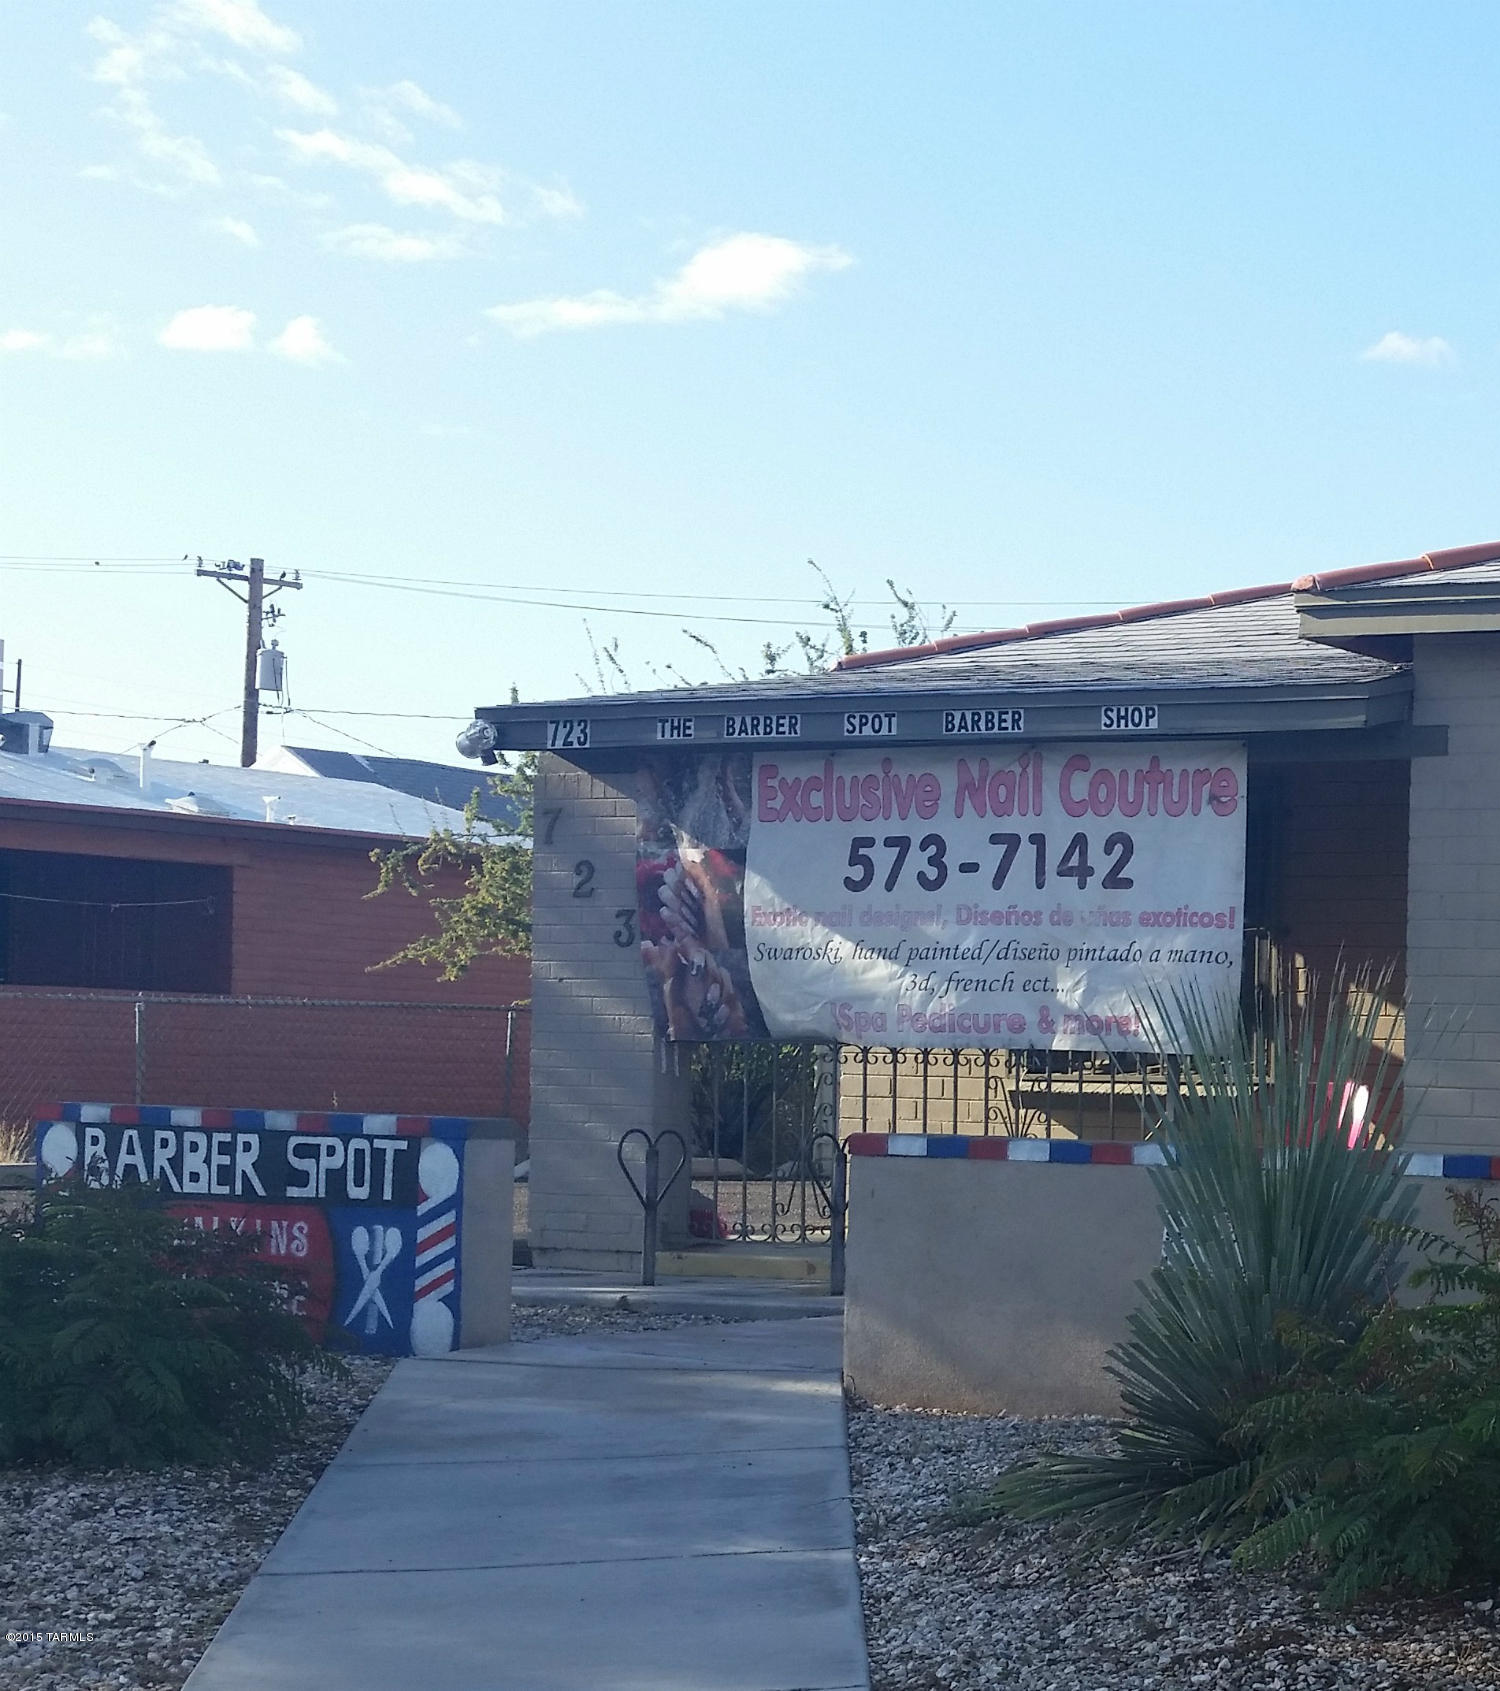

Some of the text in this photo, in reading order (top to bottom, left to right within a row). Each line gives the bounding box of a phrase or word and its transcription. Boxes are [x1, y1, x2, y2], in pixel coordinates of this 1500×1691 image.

[549, 707, 1157, 747] 723 THE BARBER SPOT BARBER SHOP
[757, 751, 1239, 823] Exclusive Nail Couture
[842, 831, 1135, 893] 573-7142
[753, 940, 843, 966] Swaroski,
[852, 940, 900, 961] hand
[1065, 940, 1143, 969] pintado
[1148, 951, 1162, 964] a
[1167, 949, 1234, 970] mano,
[905, 970, 936, 995] 3d,
[938, 970, 1015, 999] french
[897, 1004, 1028, 1035] Pedicure
[1036, 1004, 1057, 1036] &
[83, 1127, 408, 1200] BARBER SPOT
